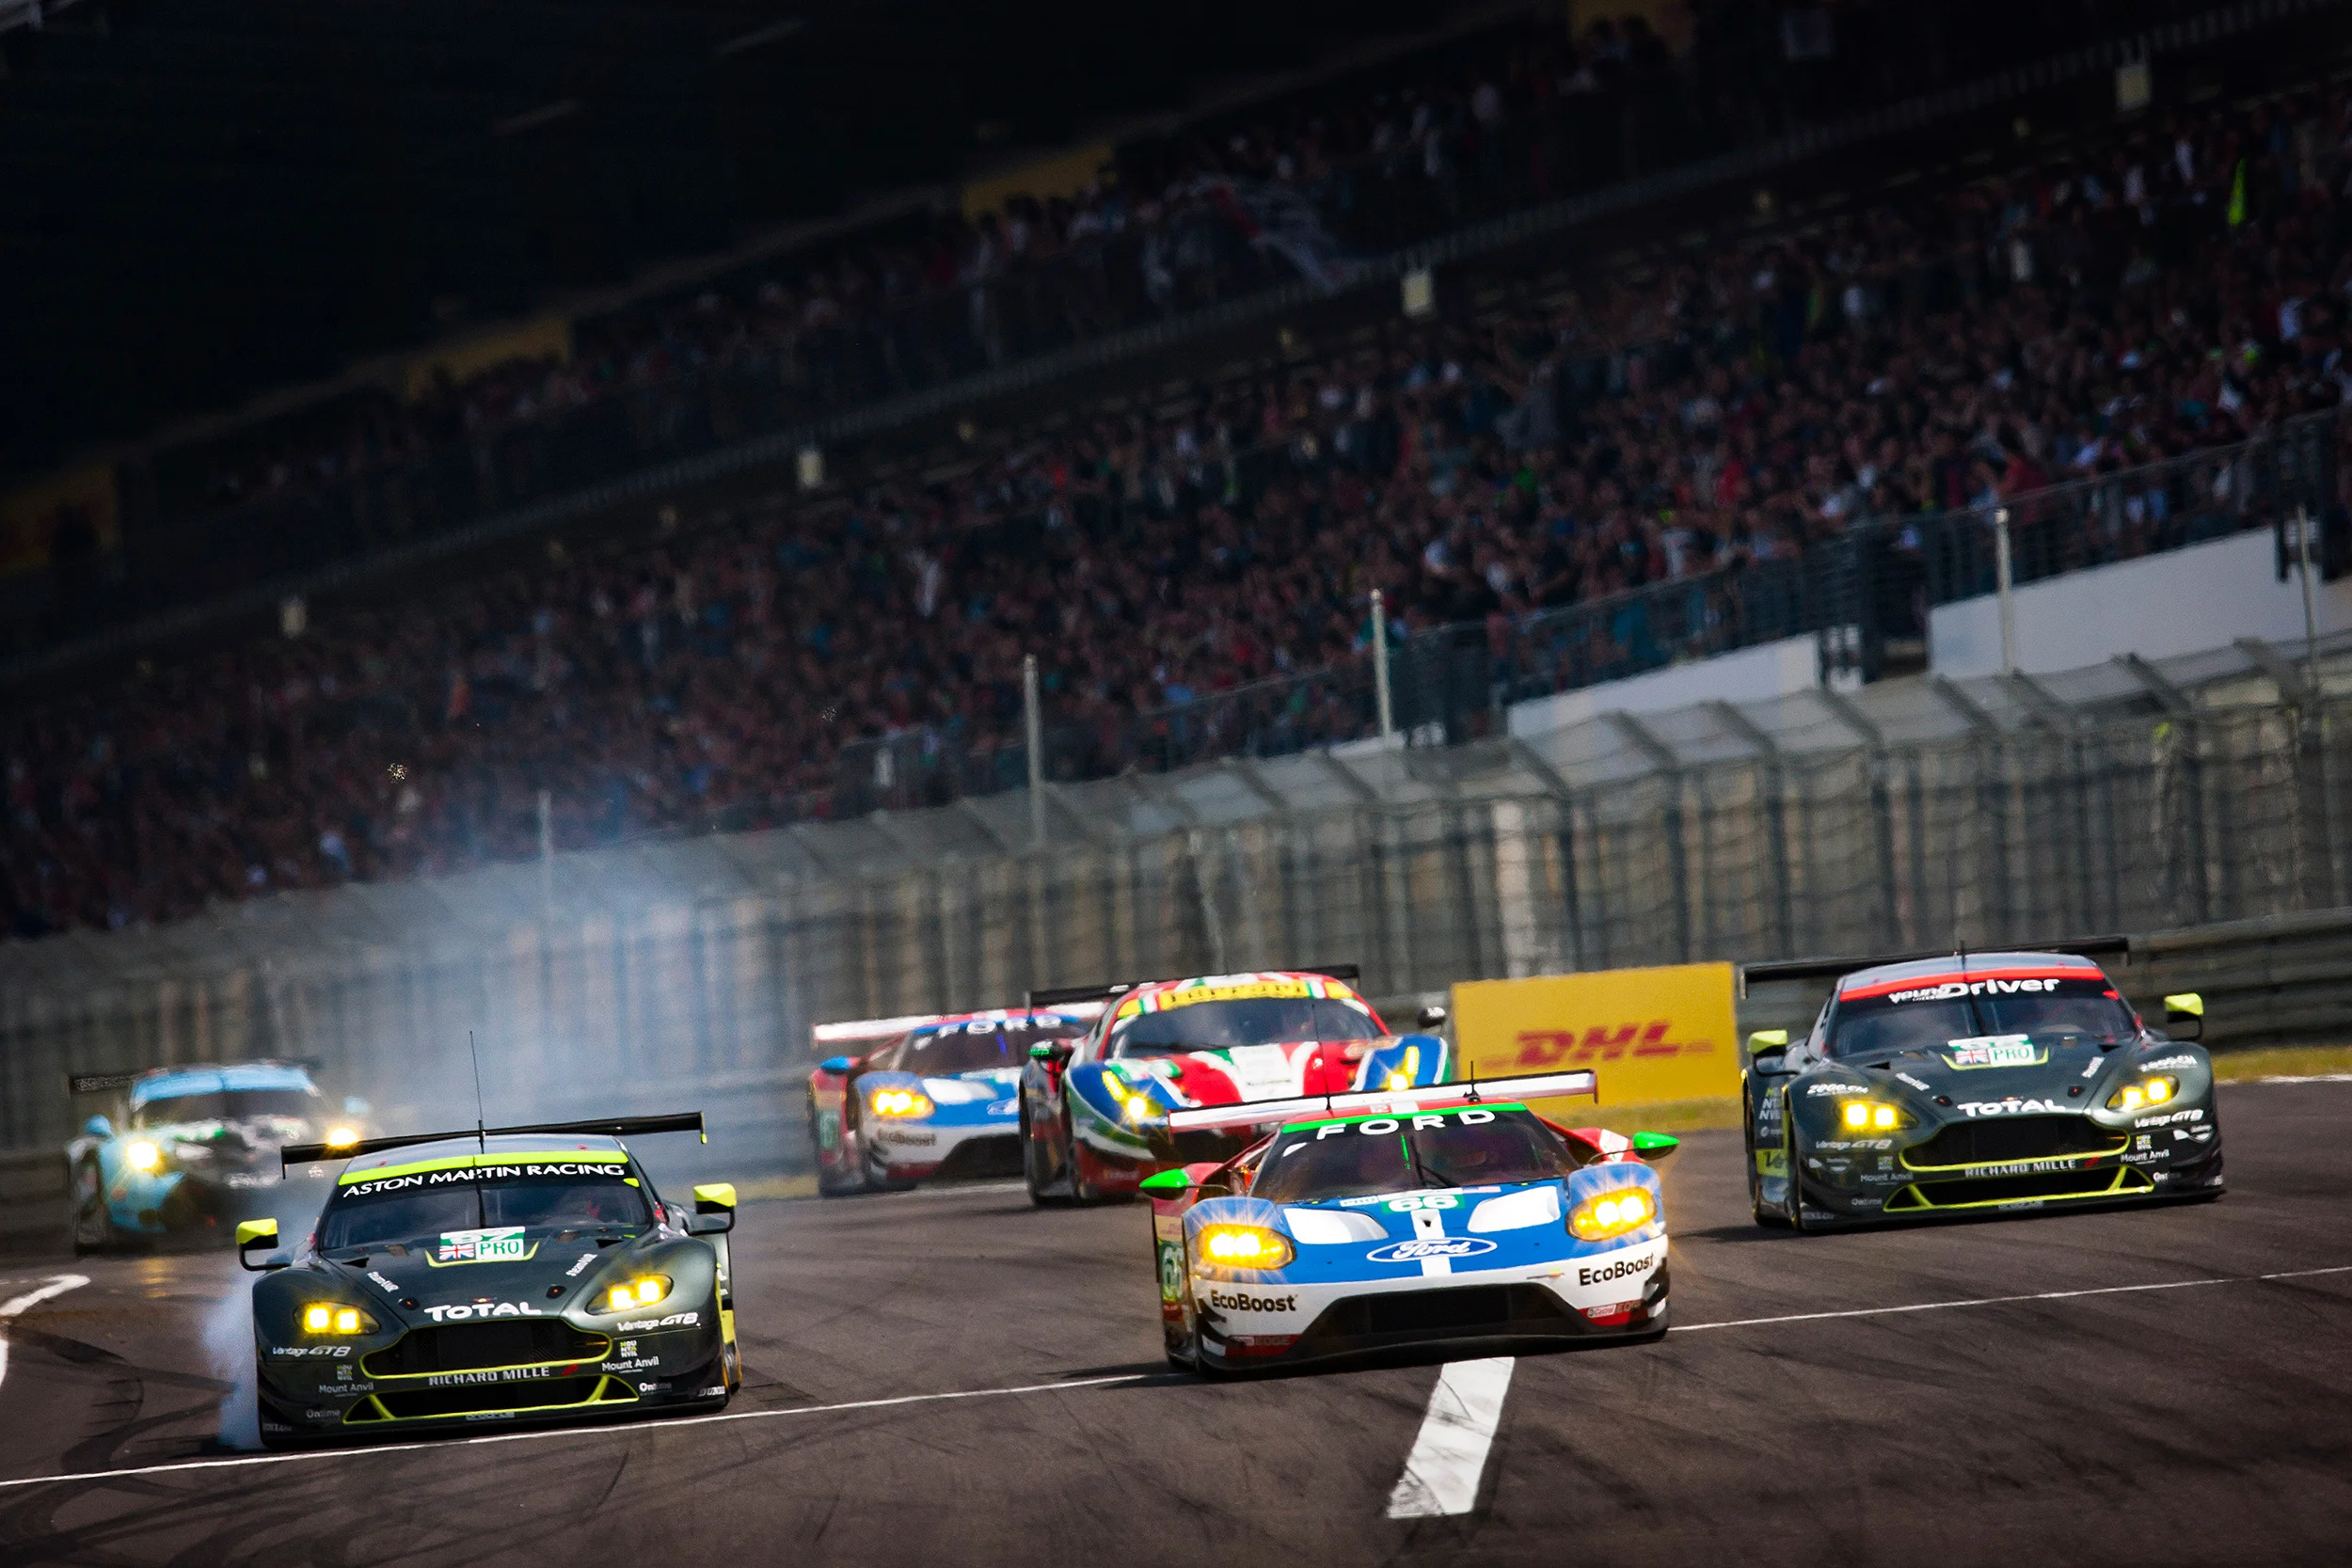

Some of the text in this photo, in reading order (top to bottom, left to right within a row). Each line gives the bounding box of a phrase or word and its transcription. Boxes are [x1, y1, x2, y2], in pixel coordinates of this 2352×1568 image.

[1938, 978, 2060, 1001] Driver
[1515, 1020, 1680, 1068] DHL
[1993, 1046, 2031, 1061] PRO
[1957, 1099, 2067, 1117] TOTAL
[1316, 1109, 1496, 1141] FORD
[2120, 1151, 2148, 1163] Mount
[1964, 1159, 2077, 1178] RICHARD MILLE
[342, 1164, 626, 1199] ASTON MARTIN RACING
[1388, 1195, 1459, 1212] 66
[479, 1241, 521, 1257] PRO
[1391, 1238, 1471, 1259] Ford
[1578, 1251, 1654, 1288] EcoBoost
[1210, 1289, 1297, 1312] EcoBoost
[423, 1301, 543, 1323] TOTAL
[659, 1311, 699, 1326] GT8
[309, 1345, 352, 1357] GT8
[601, 1355, 660, 1372] Mount Anvil
[428, 1367, 550, 1386] RICHARD MILLE
[319, 1381, 374, 1394] Mount Anvil
